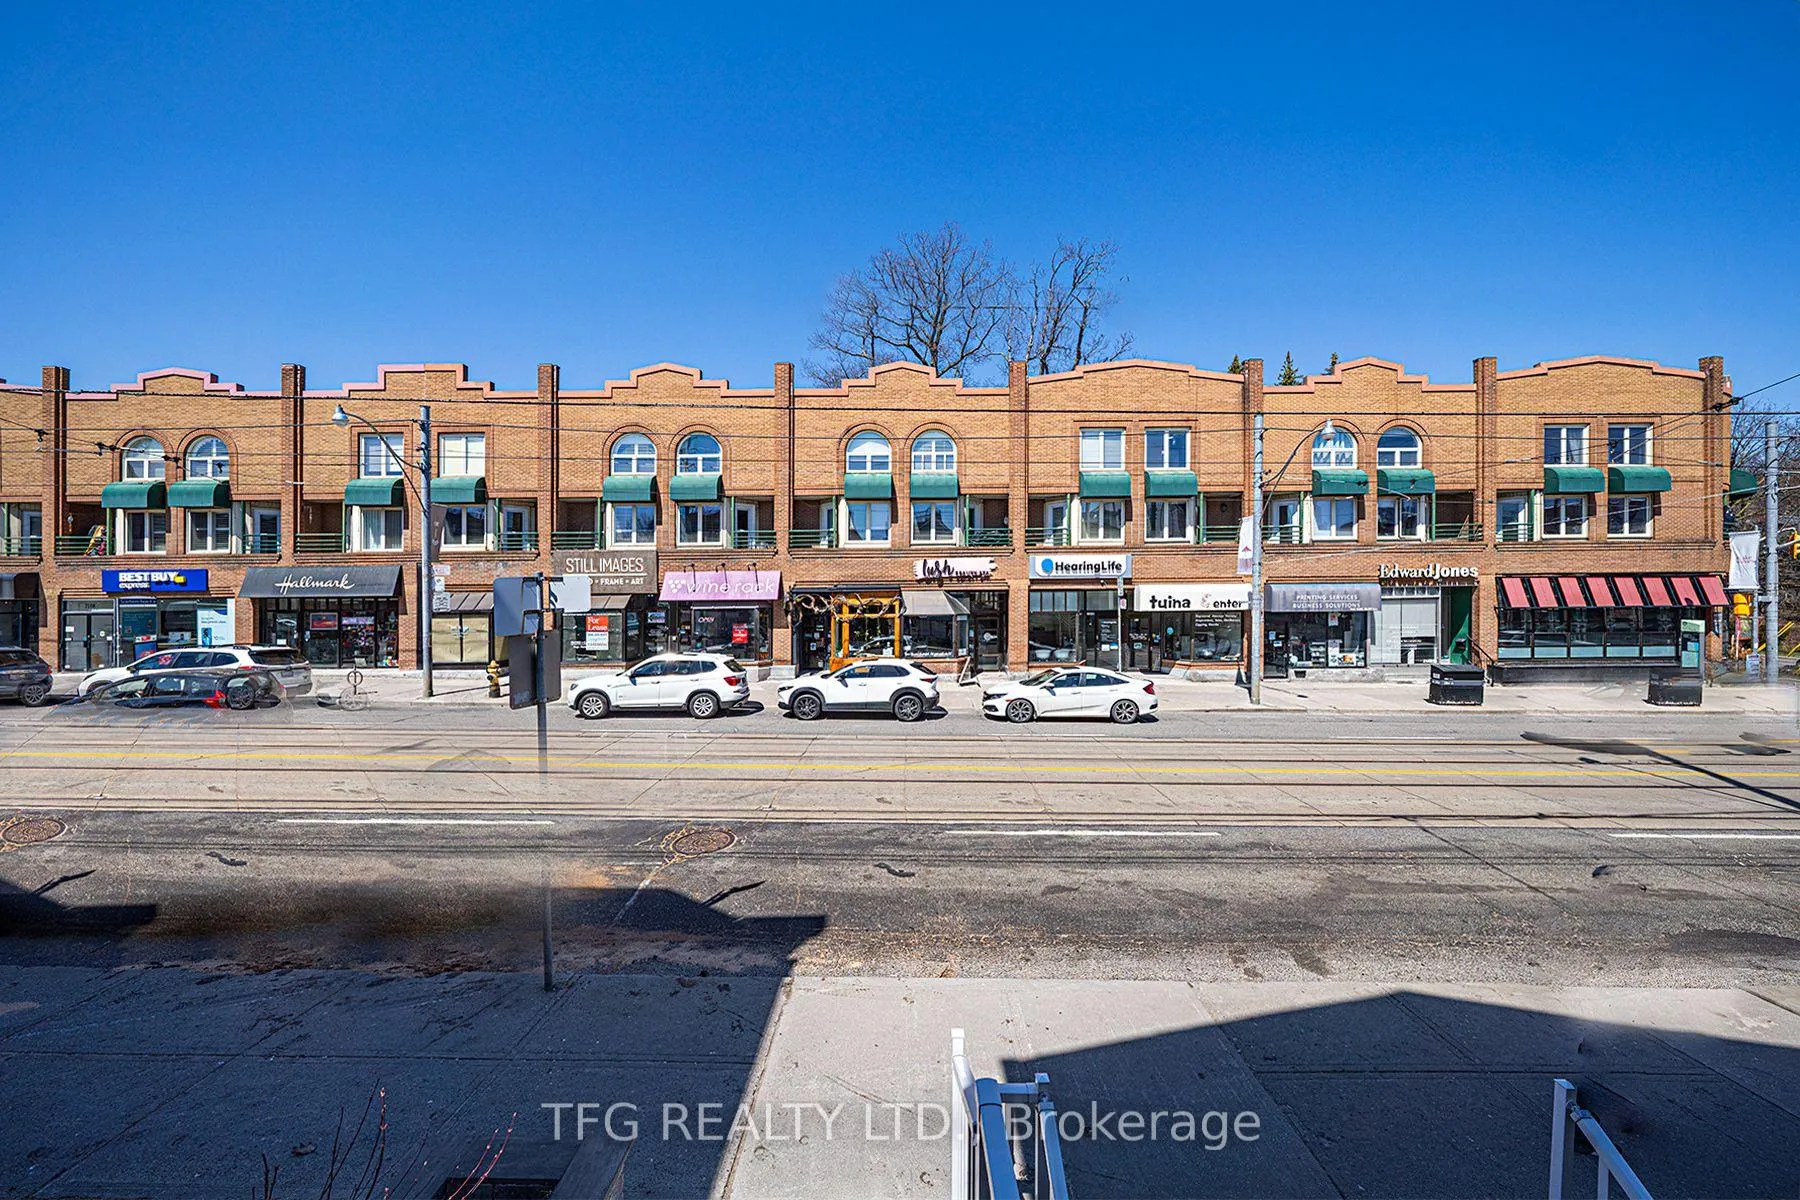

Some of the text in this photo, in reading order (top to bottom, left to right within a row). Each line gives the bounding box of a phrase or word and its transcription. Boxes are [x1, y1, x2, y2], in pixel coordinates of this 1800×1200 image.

[565, 557, 644, 573] STILL IMAGES
[1055, 561, 1122, 573] HearingLife
[119, 572, 179, 582] BEST BUY
[600, 578, 624, 586] FRAME
[630, 578, 644, 586] ART
[274, 573, 355, 596] Hallmark
[687, 577, 776, 593] wine rack
[1149, 595, 1191, 609] tuina
[587, 616, 599, 624] For
